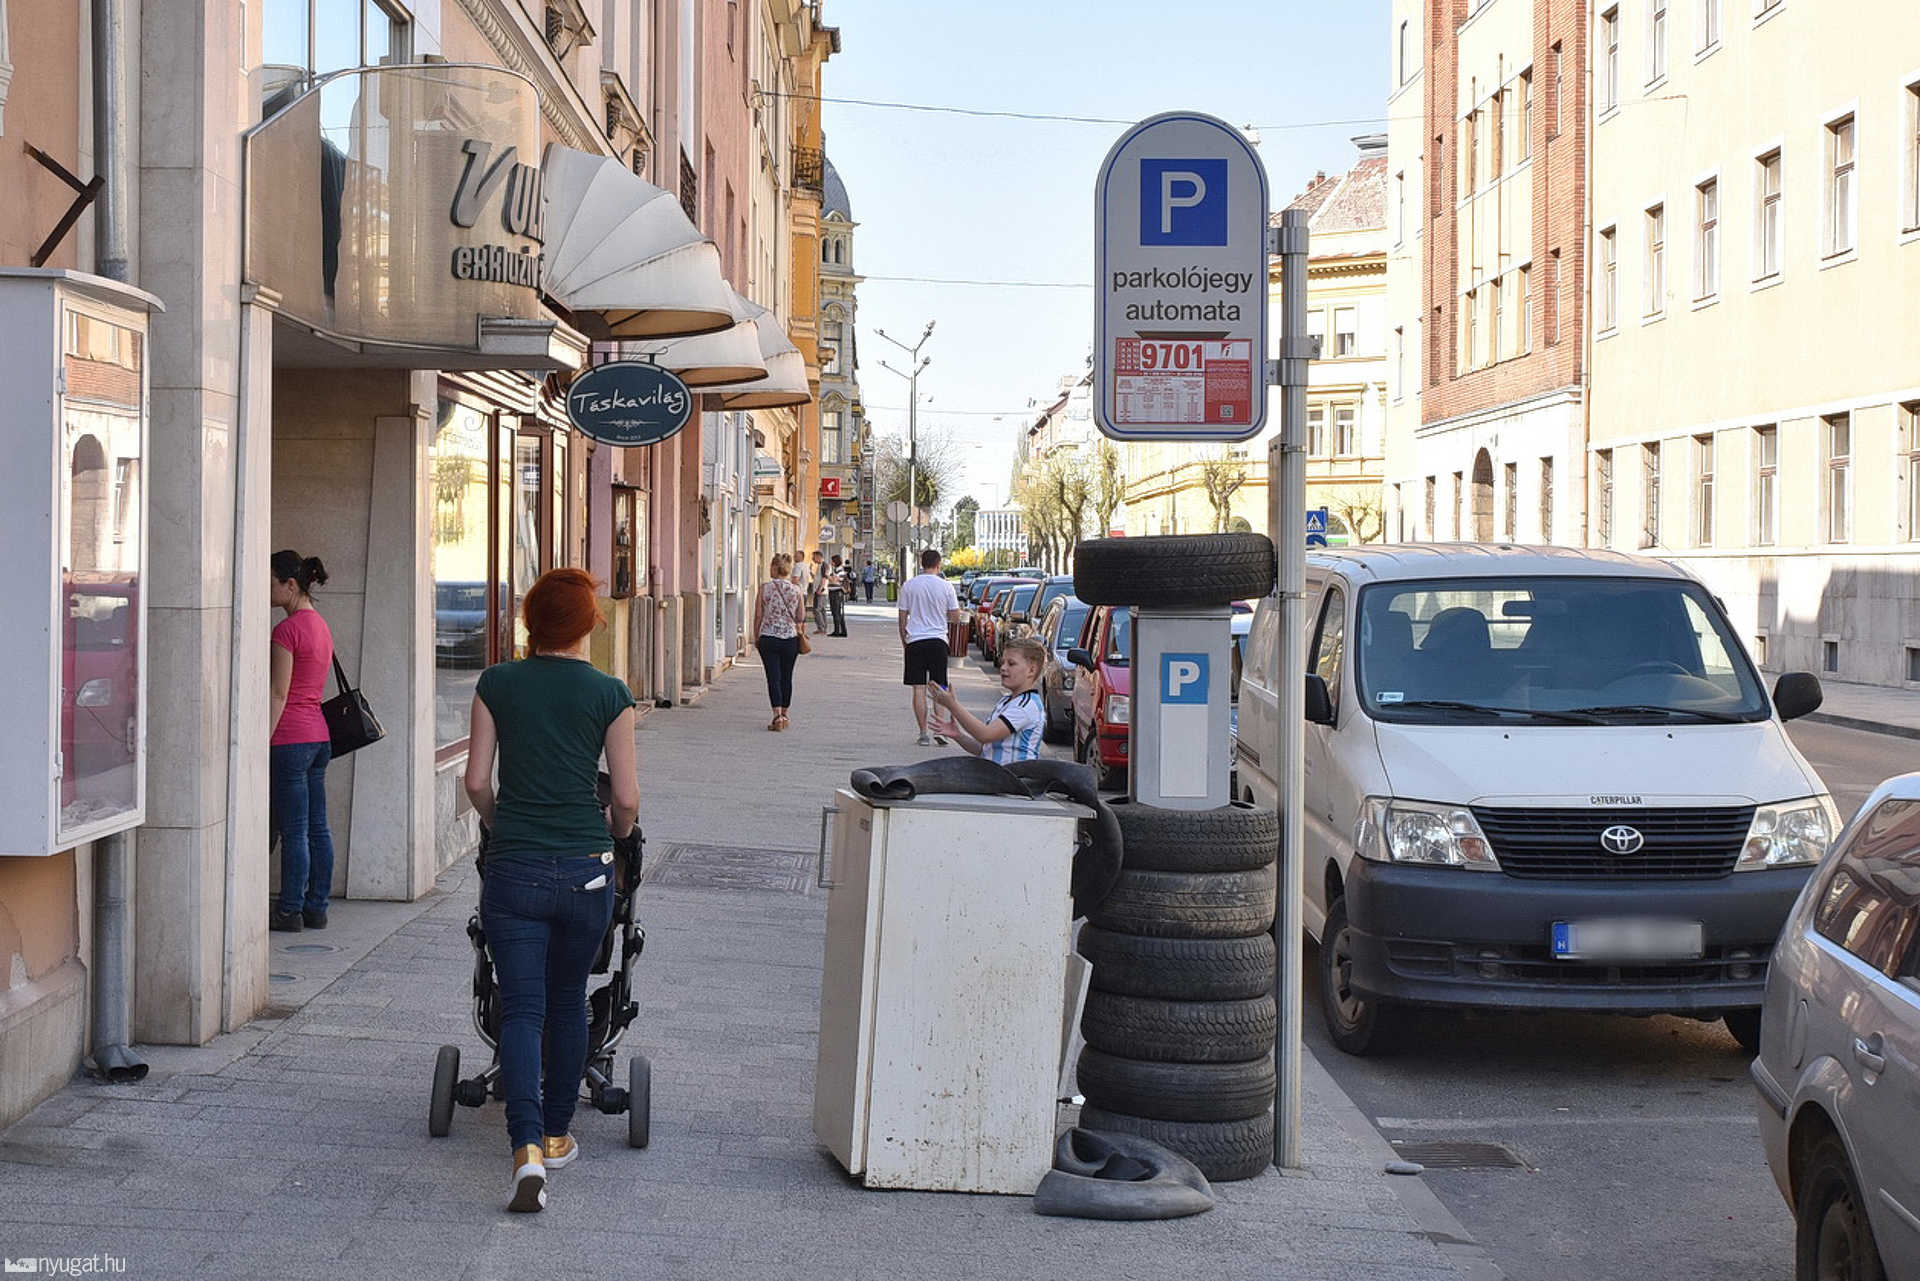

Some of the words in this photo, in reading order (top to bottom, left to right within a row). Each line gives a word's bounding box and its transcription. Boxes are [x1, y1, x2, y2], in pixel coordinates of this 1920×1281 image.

[1161, 171, 1206, 233] P
[1113, 266, 1253, 293] parkolójegy
[1126, 300, 1241, 321] automata
[1141, 343, 1203, 369] 9701
[572, 383, 685, 414] Táskavilág
[1168, 661, 1200, 696] P
[1591, 795, 1642, 805] CATERPILLAR
